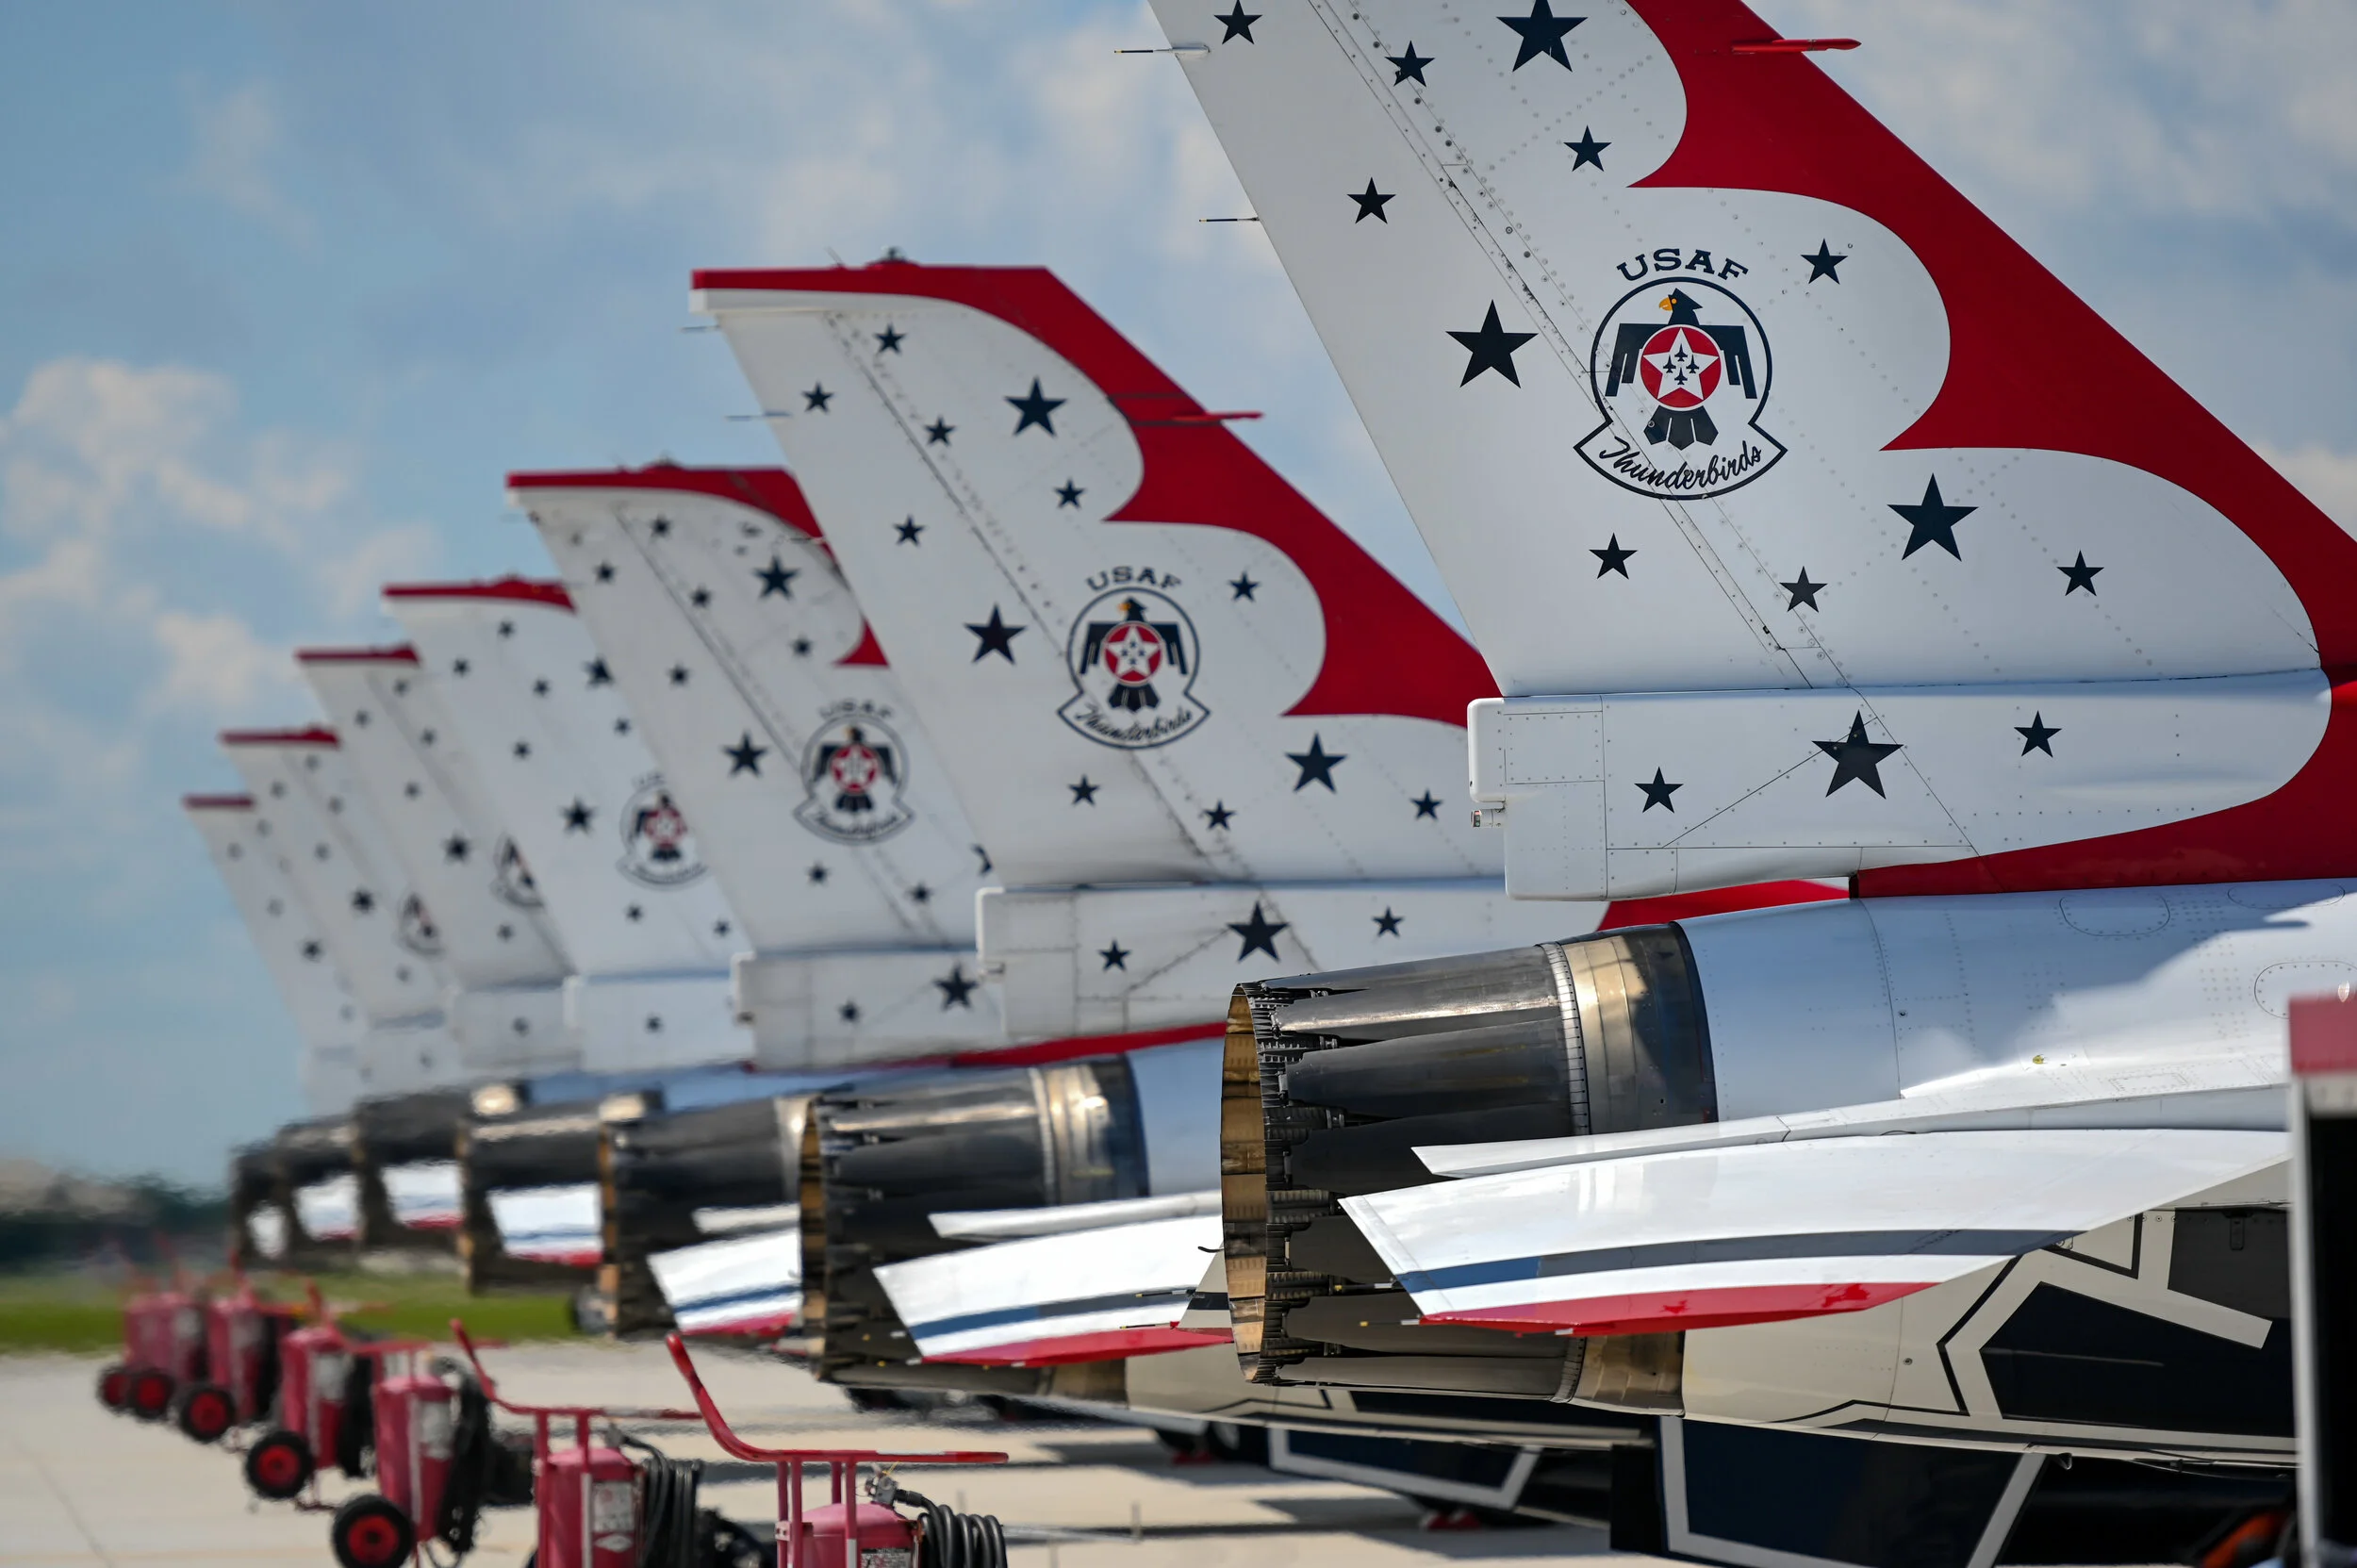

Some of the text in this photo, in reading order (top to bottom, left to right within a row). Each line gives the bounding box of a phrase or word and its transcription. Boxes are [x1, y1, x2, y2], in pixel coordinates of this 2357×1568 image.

[1616, 248, 1749, 281] USAF
[1599, 436, 1761, 489] Thunderbirds
[1085, 566, 1181, 591] USAF
